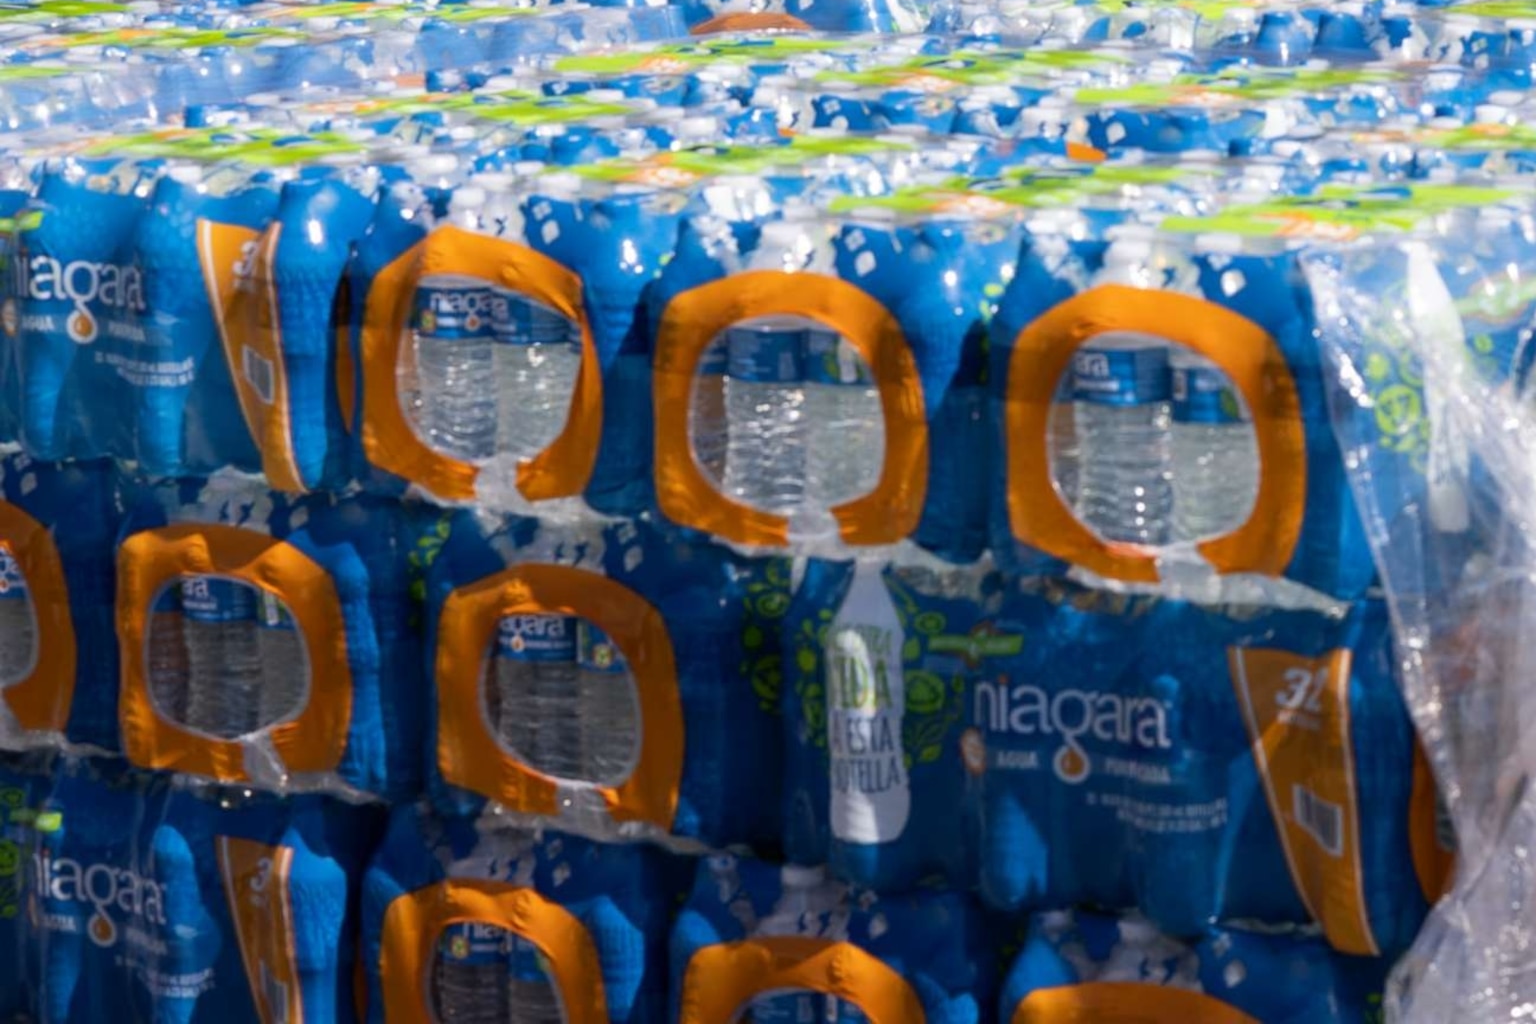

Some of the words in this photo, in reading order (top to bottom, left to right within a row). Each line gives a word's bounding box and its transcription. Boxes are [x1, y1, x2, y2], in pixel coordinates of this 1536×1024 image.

[833, 657, 893, 709] IDA
[1275, 666, 1328, 713] 32
[974, 674, 1172, 784] niagara
[832, 754, 902, 795] OTELLA
